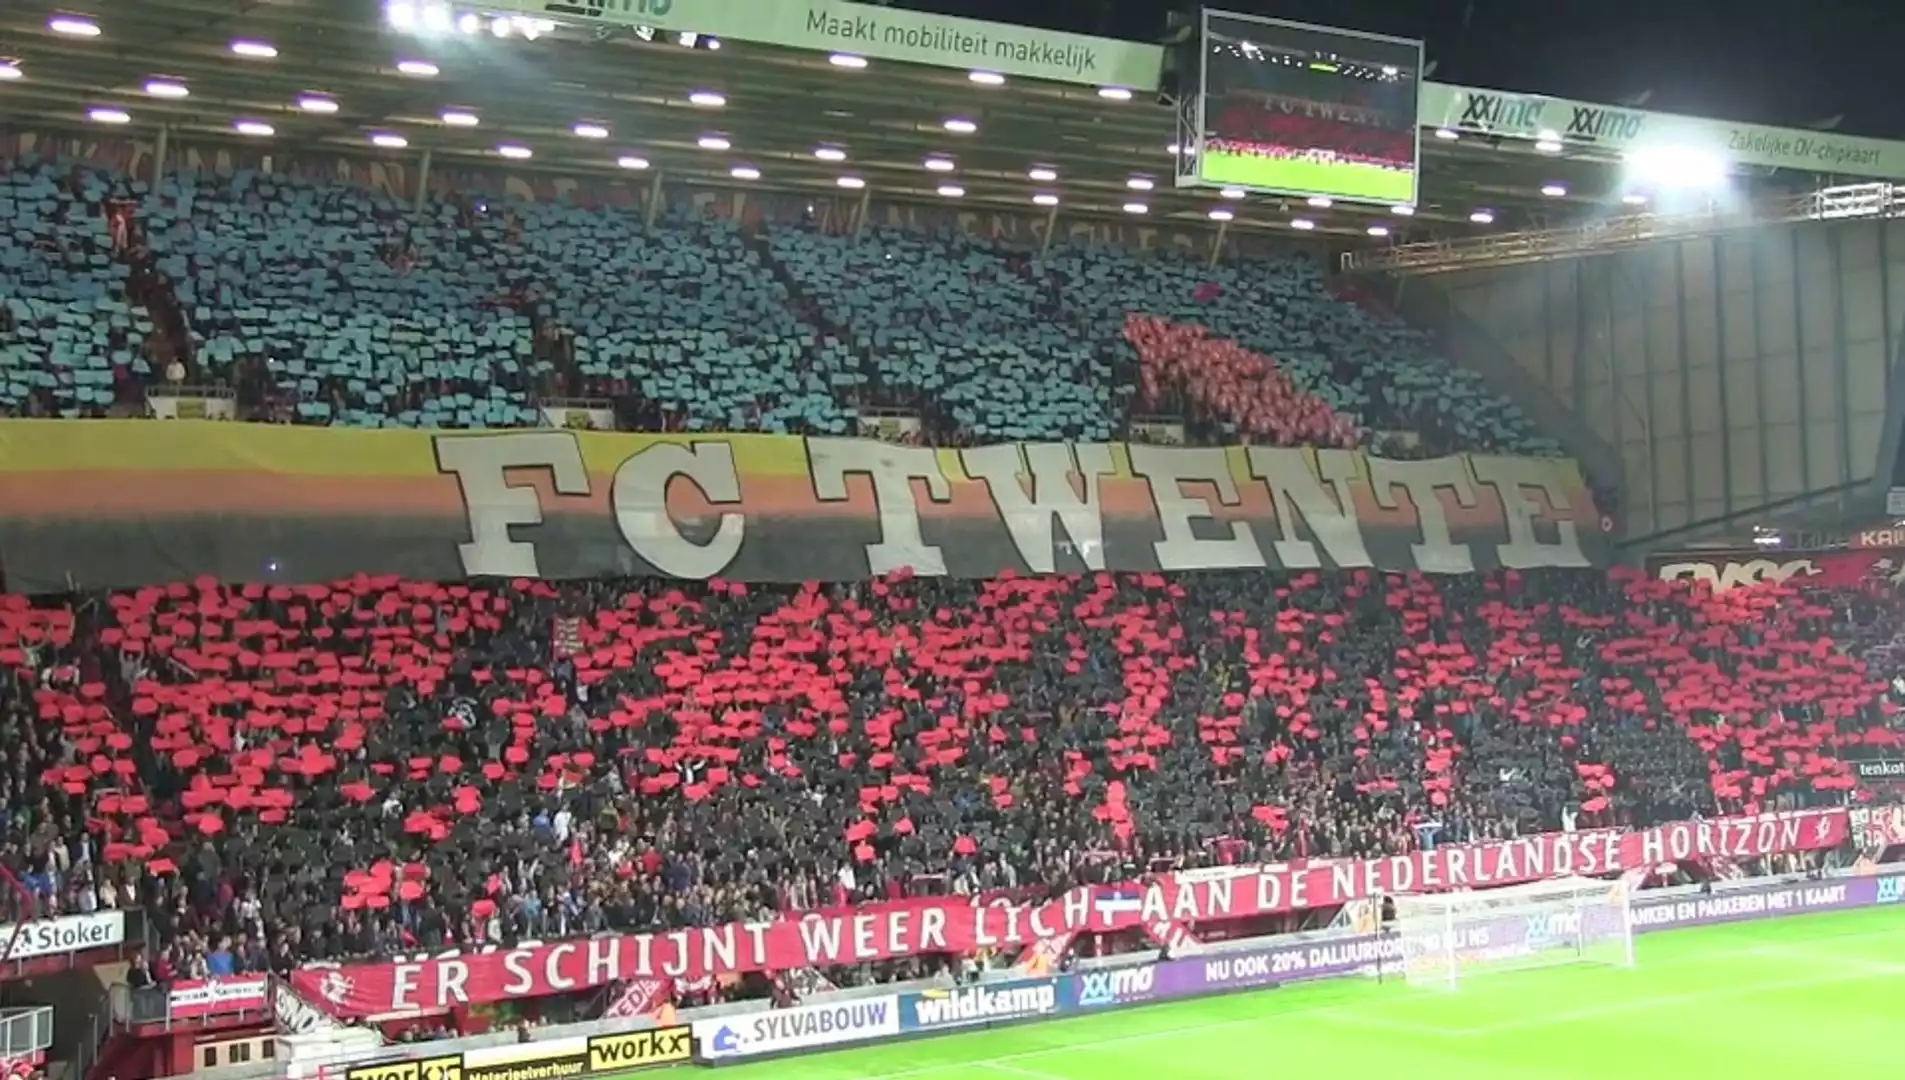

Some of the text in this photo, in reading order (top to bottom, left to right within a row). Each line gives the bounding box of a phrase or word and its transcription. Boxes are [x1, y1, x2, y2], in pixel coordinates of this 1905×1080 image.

[806, 9, 1098, 75] Maakt mobiliteit makkelijk
[433, 432, 1593, 578] FC TWENTE
[503, 922, 772, 994] SCHIJNT
[799, 907, 947, 962] WEER
[1141, 877, 1232, 921] AAN
[1257, 870, 1308, 910] DE
[1332, 832, 1621, 899] NEDERLANDSE
[1641, 817, 1801, 865] HORIZON
[1677, 901, 1696, 919] EN
[1804, 885, 1846, 906] KAART
[37, 921, 113, 950] Stoker
[1204, 960, 1229, 982] NU
[1233, 955, 1269, 976] OOK
[1271, 950, 1306, 972] 20%
[753, 1000, 888, 1043] SYLVABOUW
[915, 984, 1055, 1025] wildkamp
[597, 1026, 685, 1063] workx
